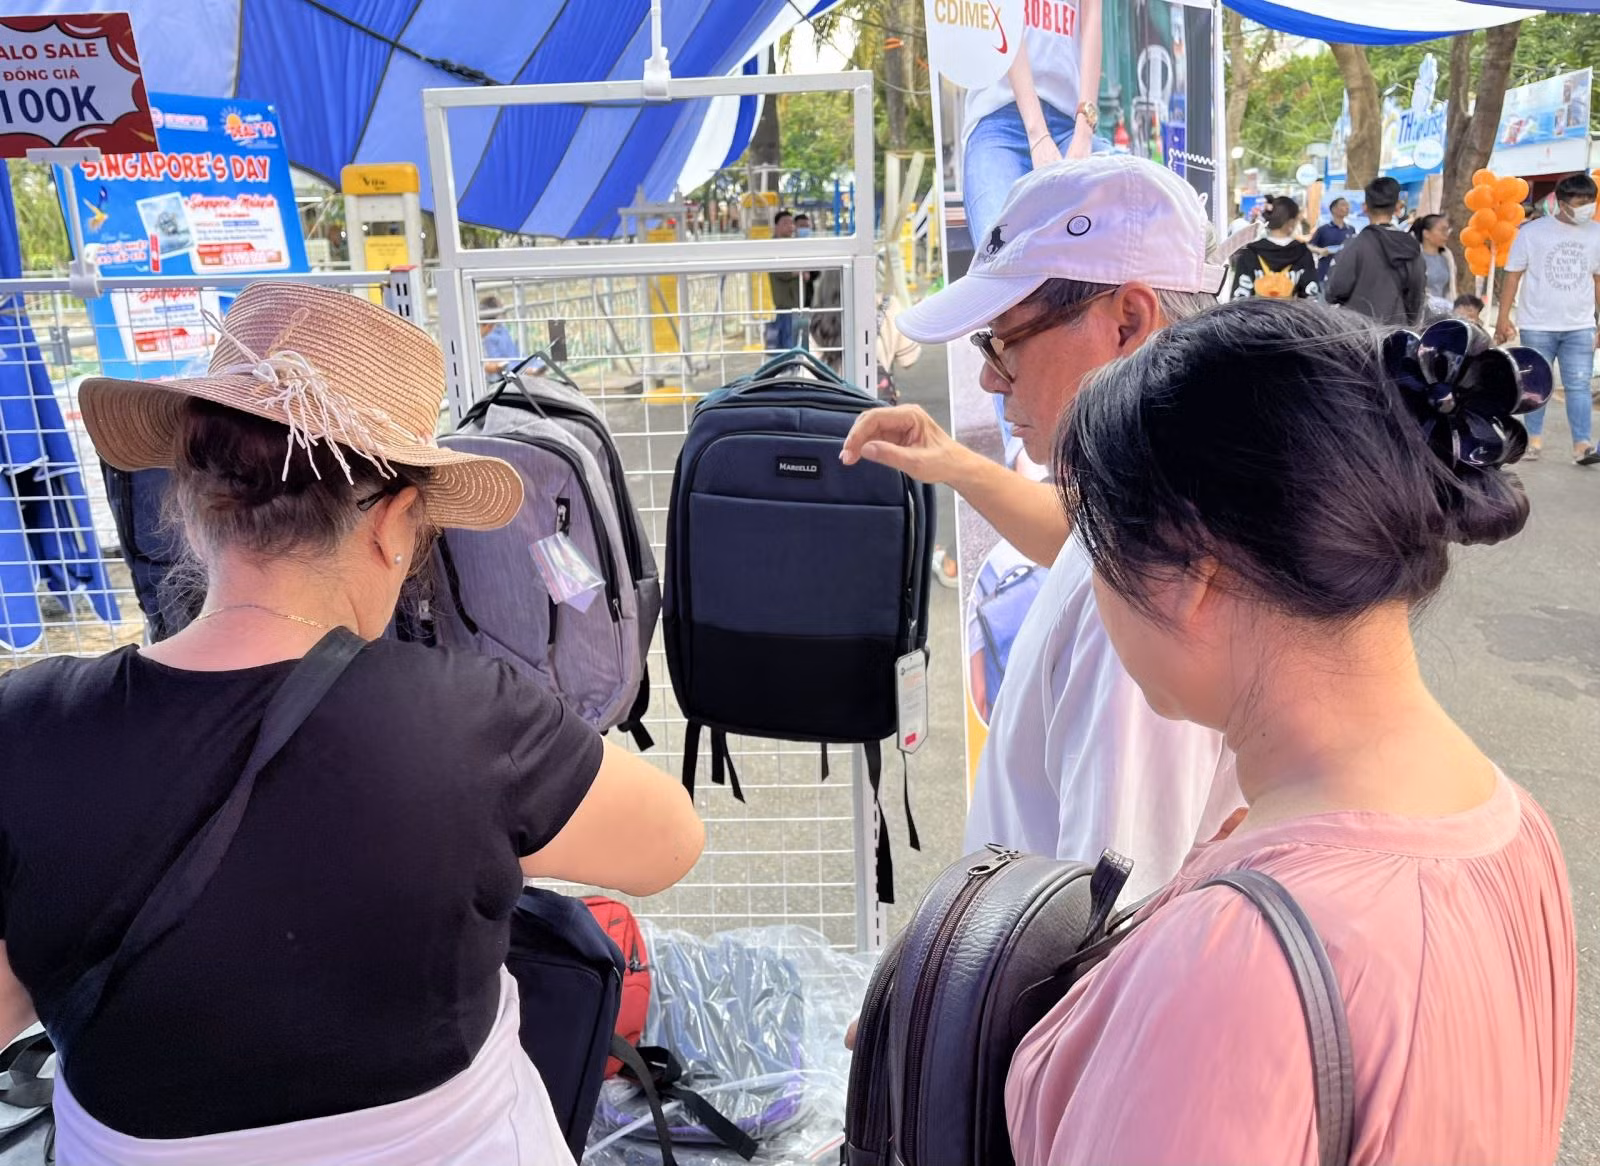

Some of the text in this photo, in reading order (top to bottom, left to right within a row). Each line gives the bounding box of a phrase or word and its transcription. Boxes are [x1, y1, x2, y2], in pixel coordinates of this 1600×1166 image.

[43, 42, 99, 59] SALE
[53, 65, 80, 80] GIÁ
[0, 85, 105, 124] 100K
[81, 152, 270, 182] SINGAPORE'S DAY
